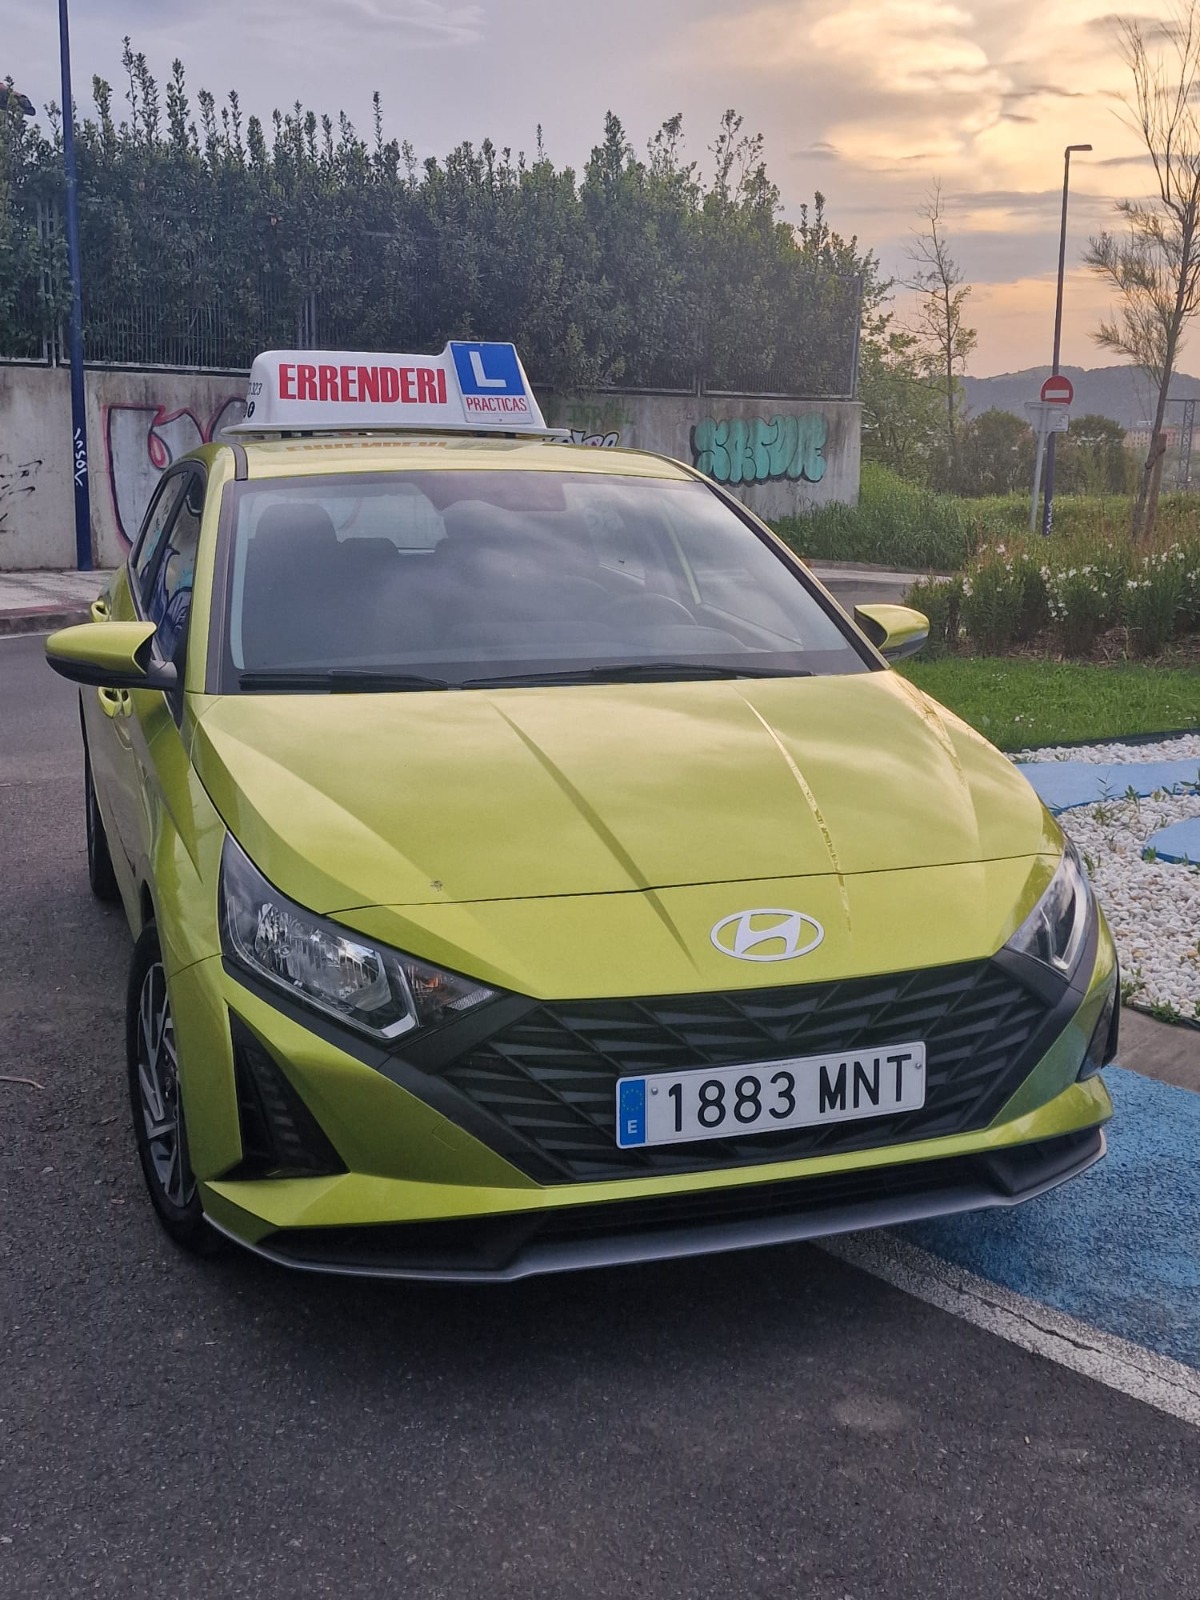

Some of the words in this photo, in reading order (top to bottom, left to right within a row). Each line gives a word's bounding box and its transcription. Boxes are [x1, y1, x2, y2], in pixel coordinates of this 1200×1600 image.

[278, 363, 448, 404] ERRENDERI
[470, 351, 507, 388] L
[465, 397, 528, 412] PRACTICAS
[668, 1071, 796, 1132] 1883
[819, 1053, 912, 1113] MNT
[627, 1119, 638, 1134] E
